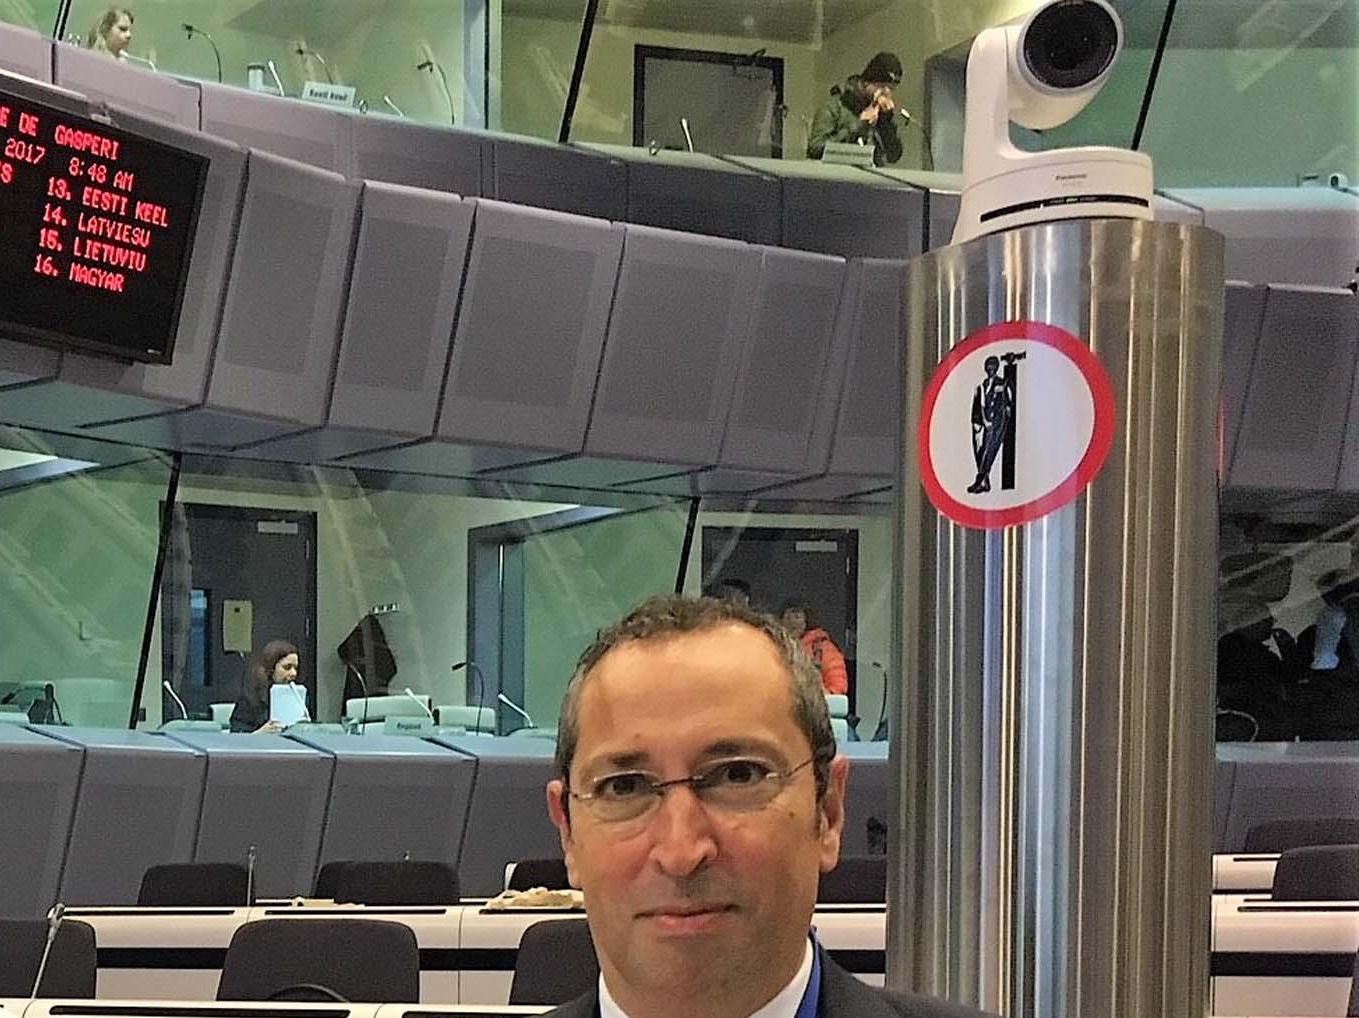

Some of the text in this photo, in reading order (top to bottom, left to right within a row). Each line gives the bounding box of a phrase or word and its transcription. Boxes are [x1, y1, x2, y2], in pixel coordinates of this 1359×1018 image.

[19, 113, 39, 135] DE
[54, 124, 119, 161] GASPERI
[4, 137, 45, 165] 2017
[68, 157, 106, 182] 8:48
[113, 172, 133, 190] AM
[43, 203, 151, 249] 14. LATVIESU
[82, 187, 127, 216] EESTI
[135, 199, 169, 228] KEEL
[38, 228, 146, 272] 15. LIETUVIU
[33, 254, 124, 292] 16. MAGYAR
